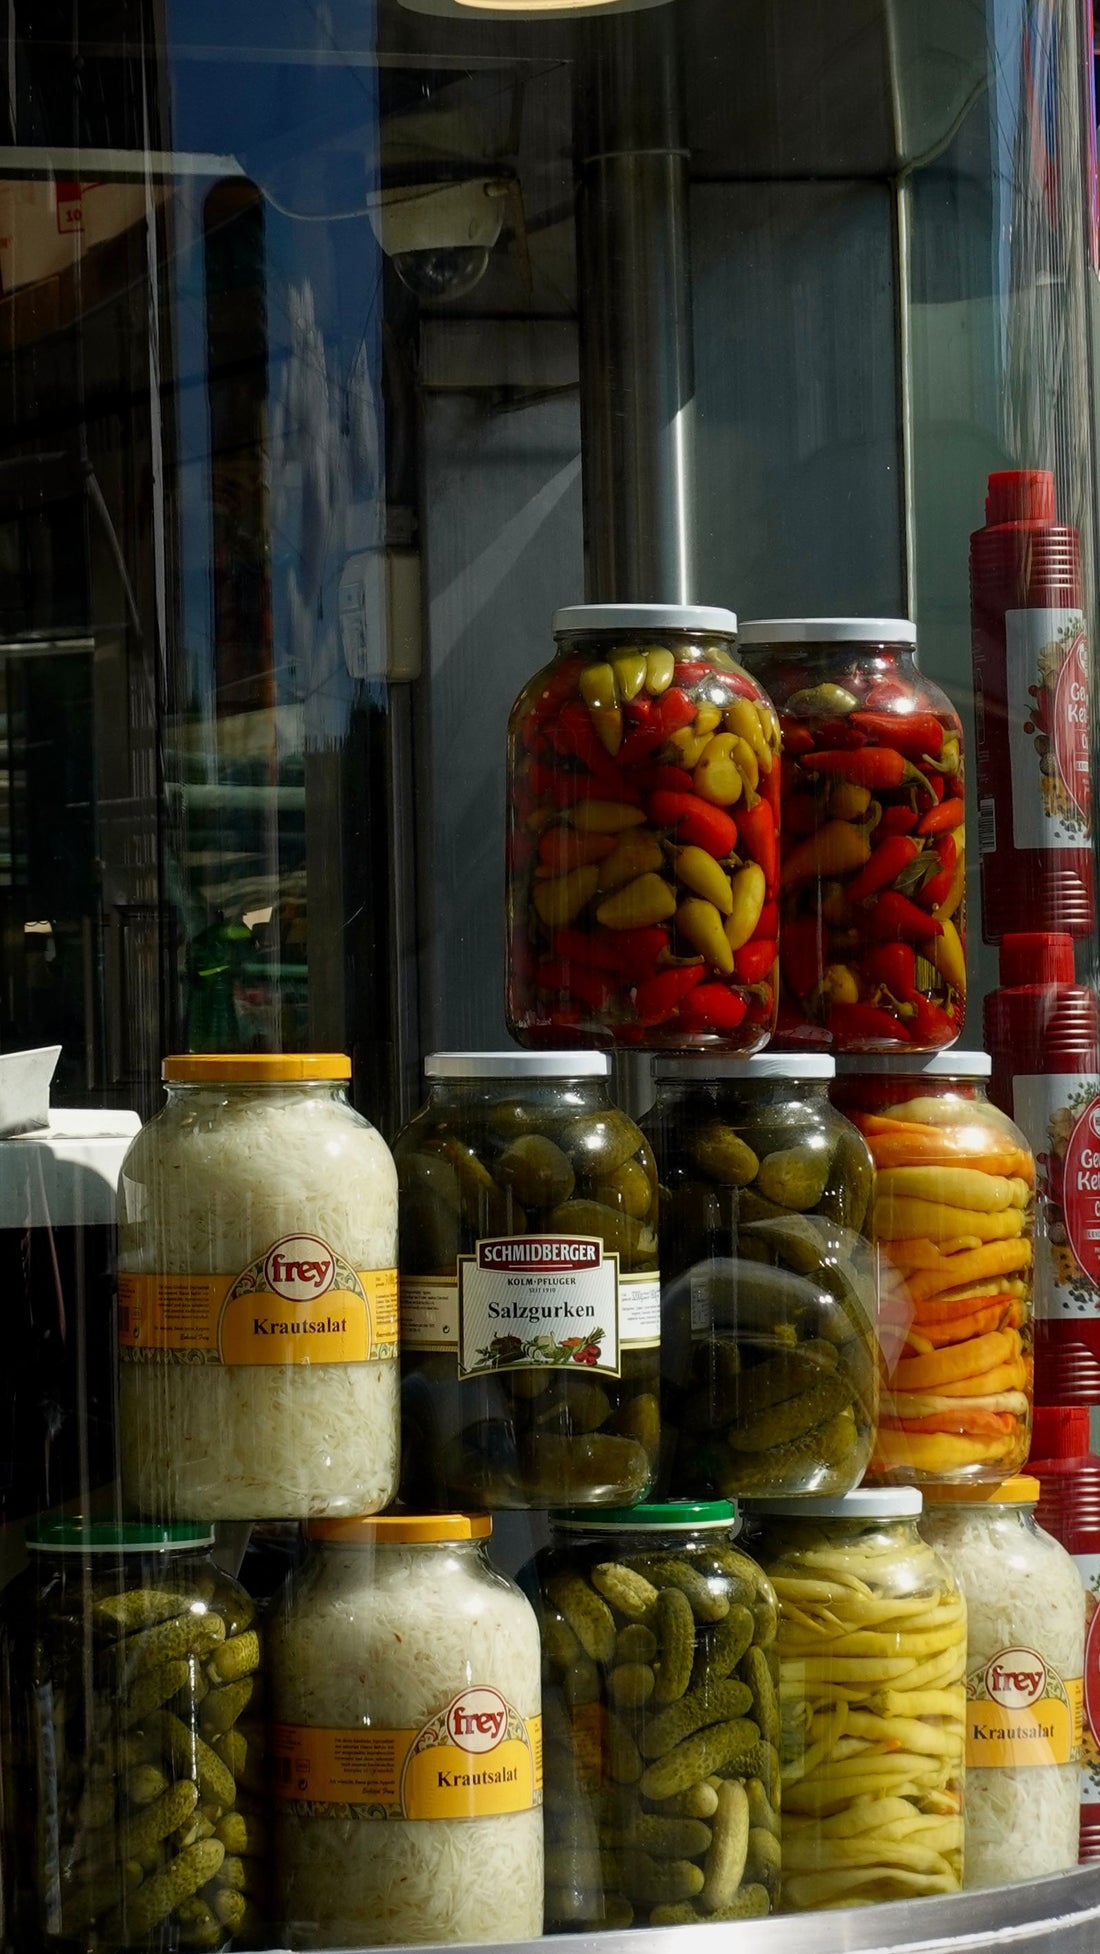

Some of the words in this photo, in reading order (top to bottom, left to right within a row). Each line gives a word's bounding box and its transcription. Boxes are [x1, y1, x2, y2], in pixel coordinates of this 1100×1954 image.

[66, 209, 82, 222] 10
[484, 1244, 596, 1262] SCHMIDBERGER
[271, 1253, 331, 1287] frey
[488, 1302, 595, 1323] Salzgurken
[253, 1317, 347, 1336] Krautsalat
[990, 1665, 1044, 1696] frey
[453, 1706, 505, 1739] frey
[973, 1724, 1054, 1740] Krautsalat
[437, 1767, 518, 1788] Krautsalat
